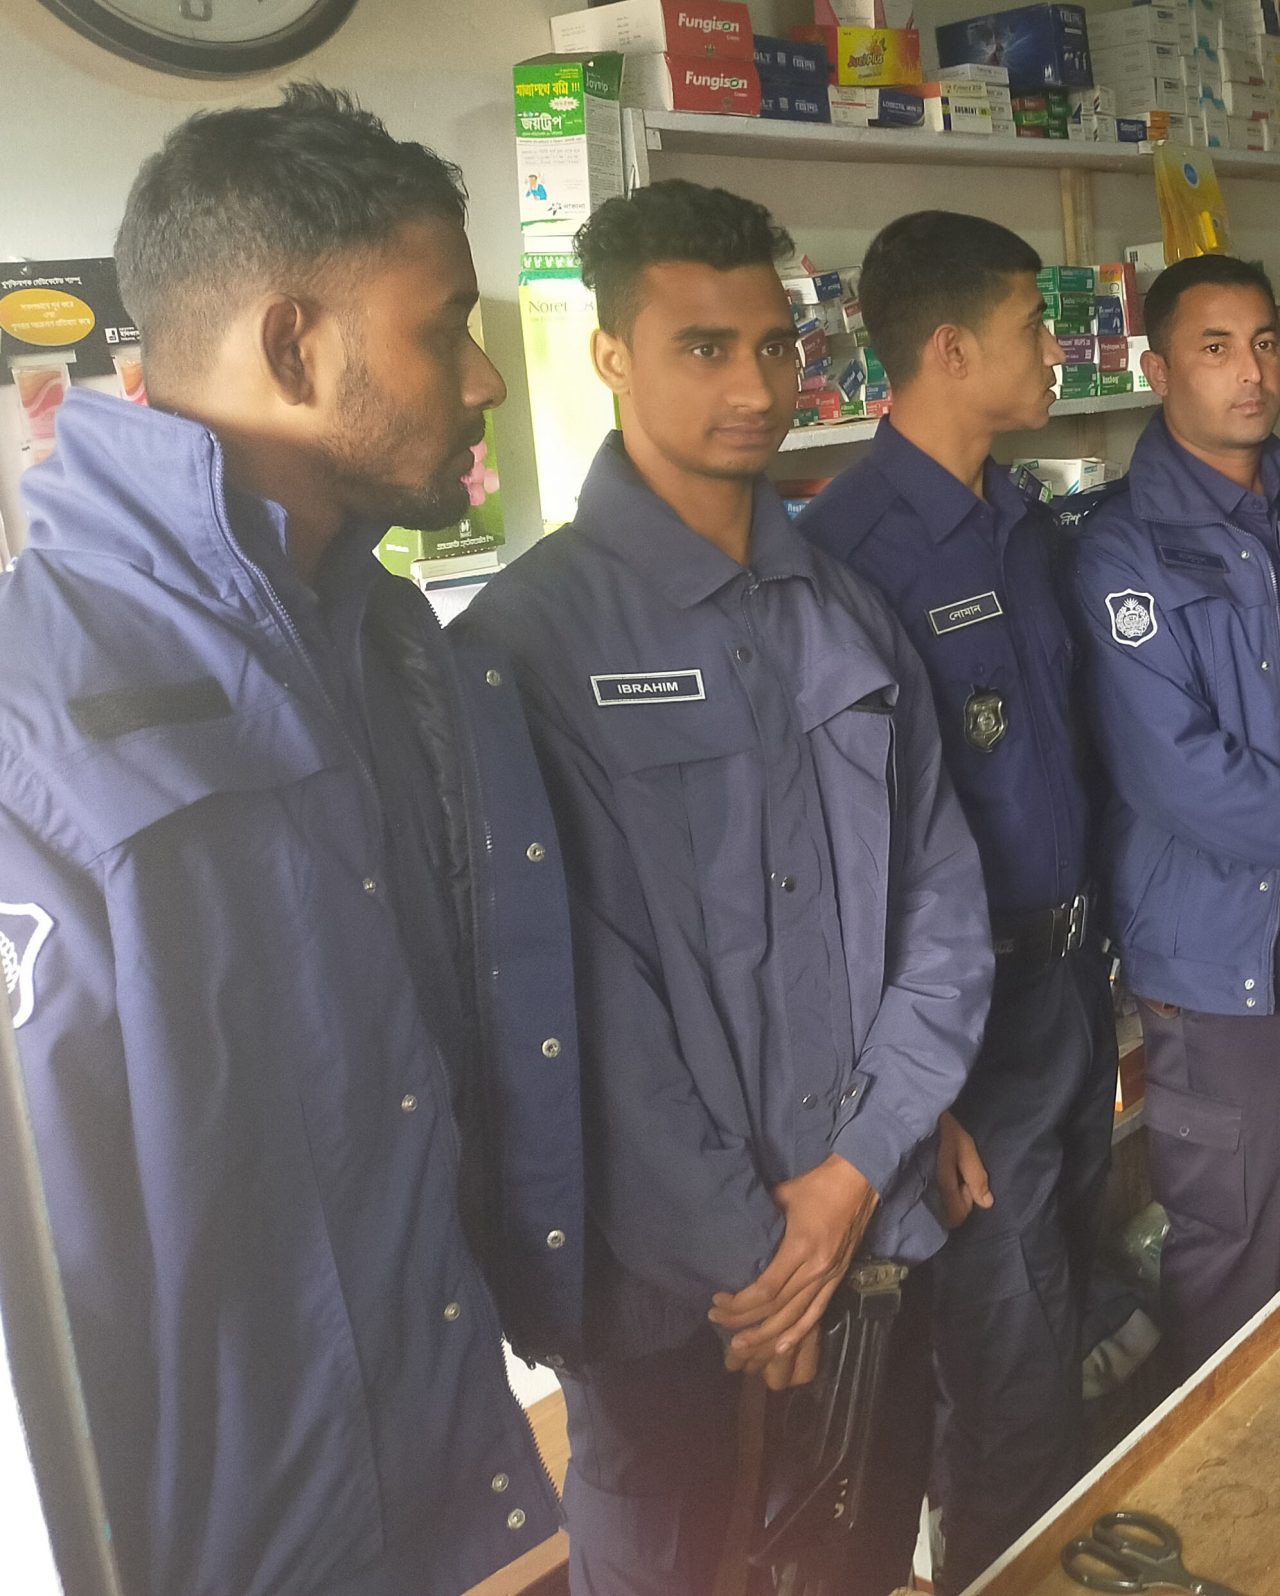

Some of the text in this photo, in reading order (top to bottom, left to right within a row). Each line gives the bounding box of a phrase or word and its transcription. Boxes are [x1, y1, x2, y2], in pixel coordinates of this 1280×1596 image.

[678, 13, 739, 33] Fungison
[552, 80, 569, 96] বমি
[685, 70, 747, 90] Fungison
[521, 112, 562, 131] জয়ট্রিপ
[949, 604, 982, 621] নোমান
[617, 681, 678, 694] IBRAHIM
